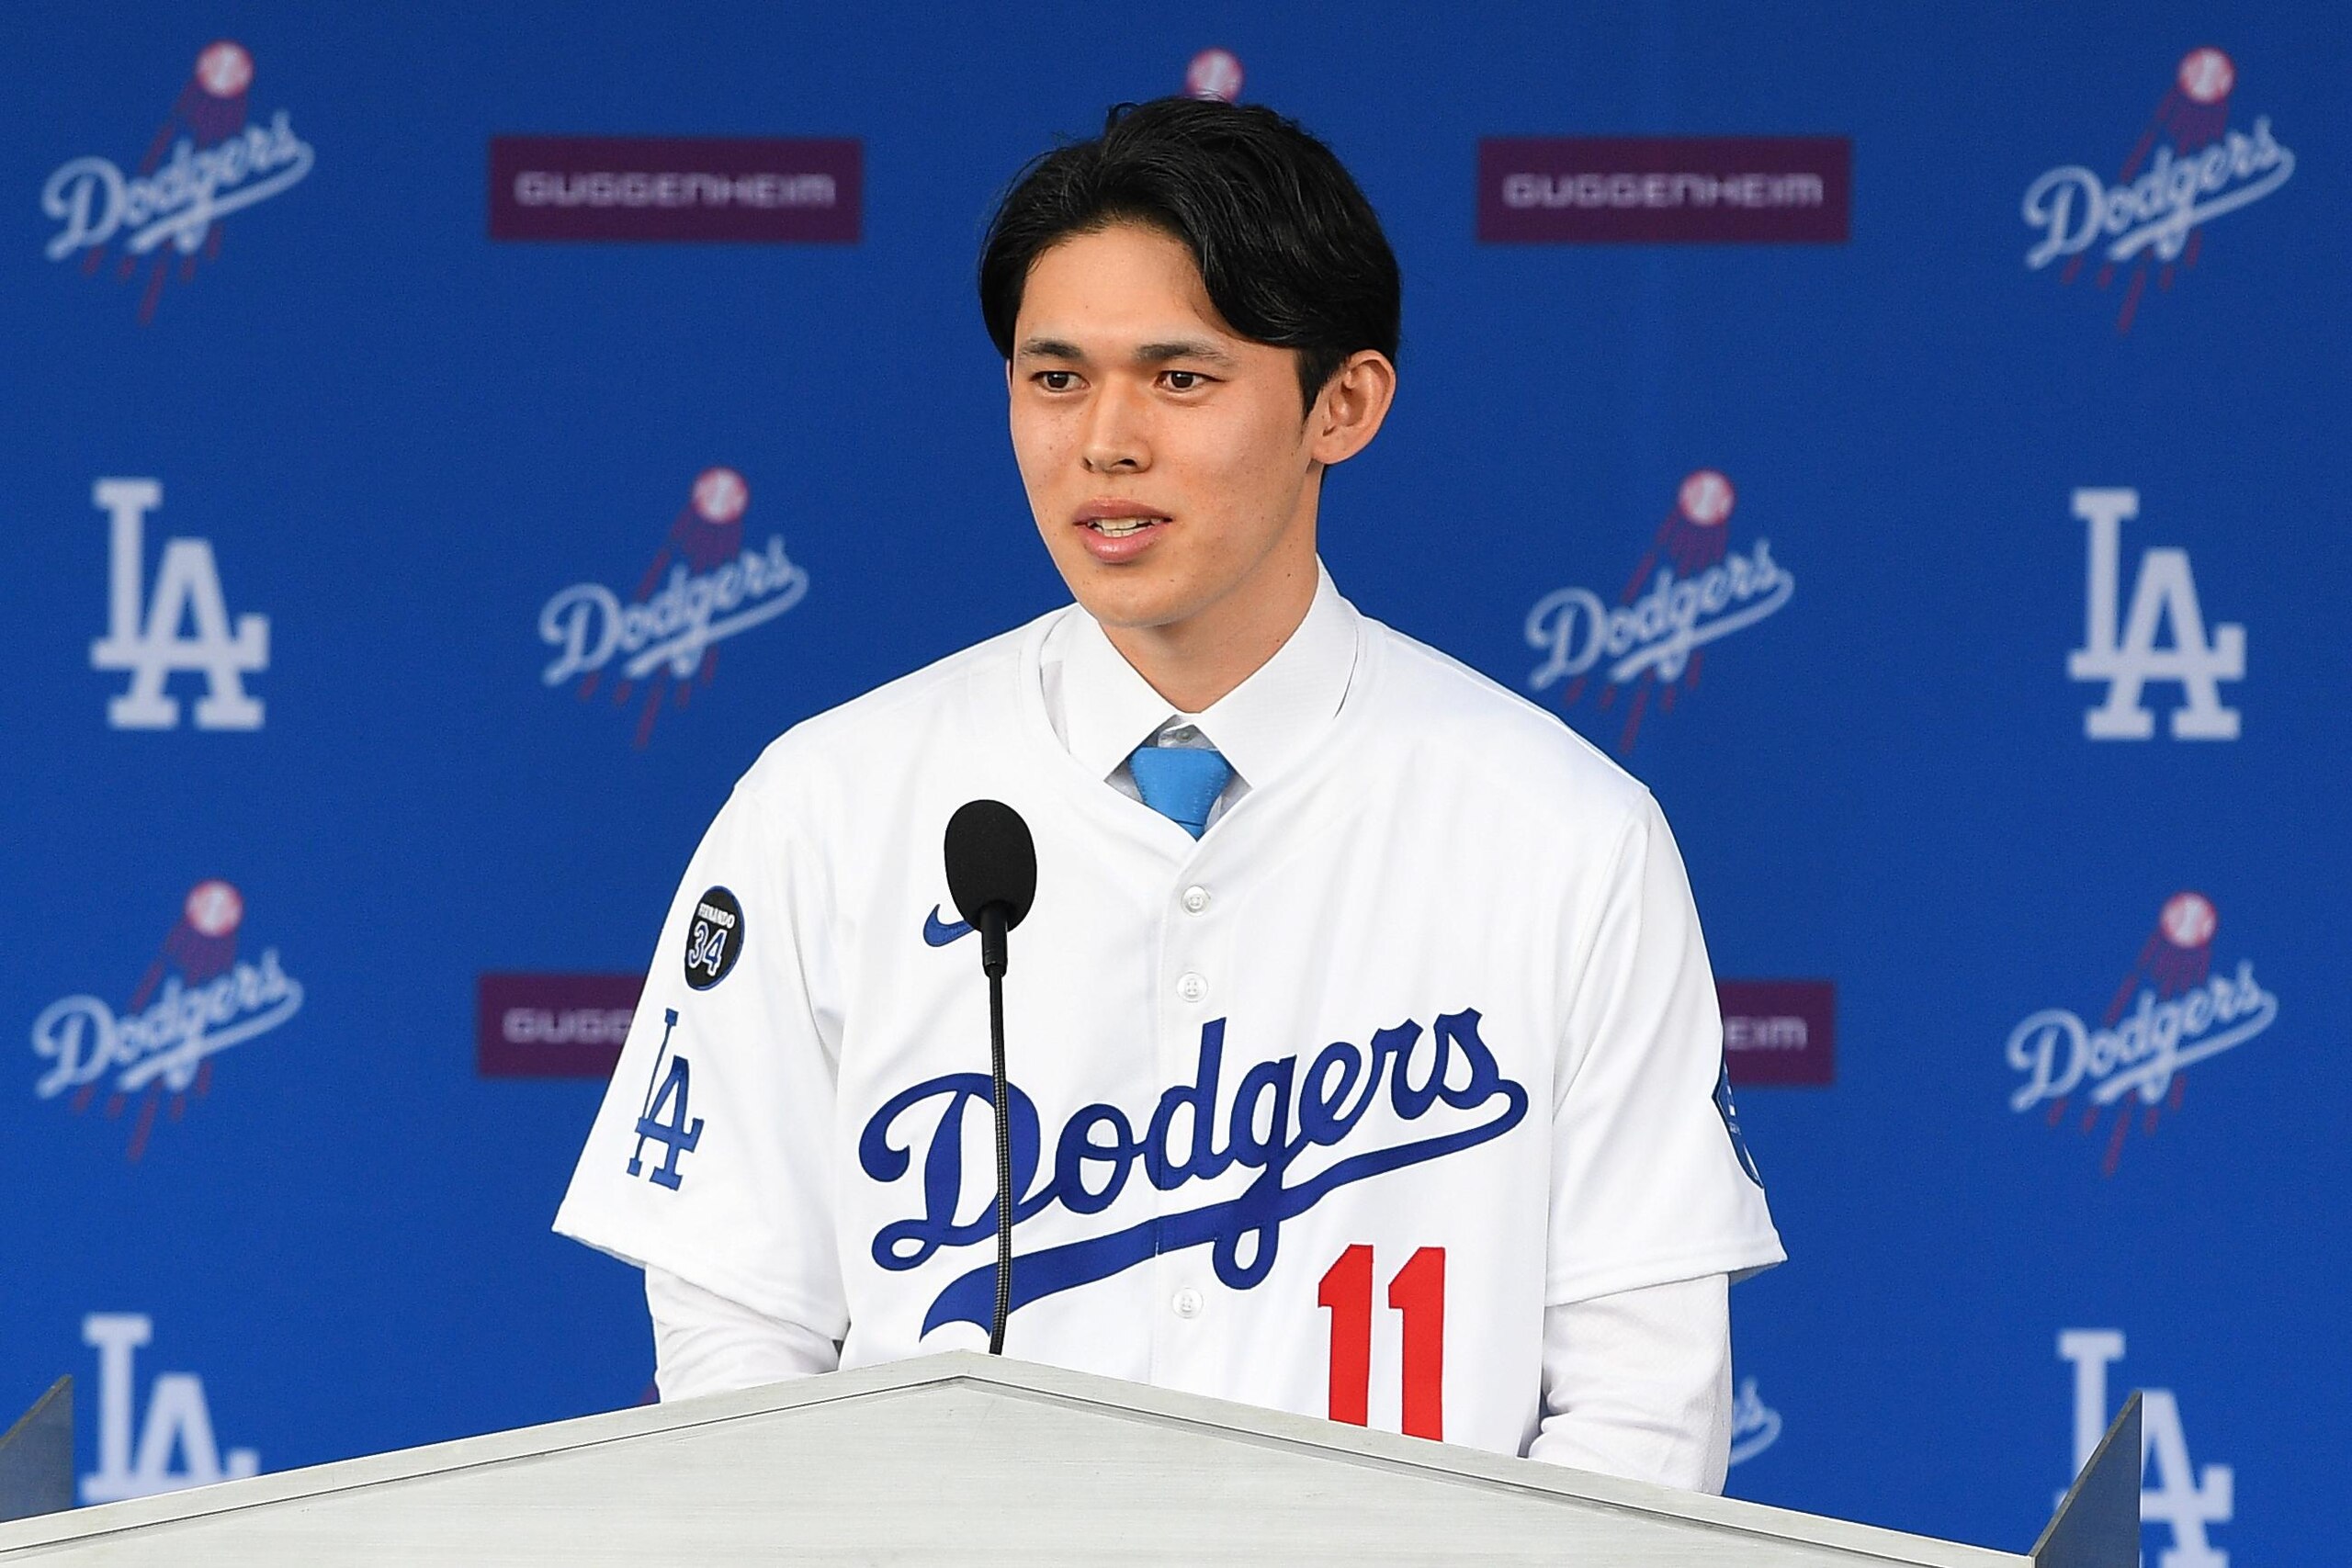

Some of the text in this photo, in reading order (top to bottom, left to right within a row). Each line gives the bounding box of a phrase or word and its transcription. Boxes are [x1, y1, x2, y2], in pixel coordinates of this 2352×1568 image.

[42, 111, 314, 261] Dodgers
[514, 171, 837, 208] GUGGENHEIM
[1502, 172, 1824, 209] GUGGENHEIM
[2023, 117, 2295, 269] Dodgers
[91, 479, 269, 730] LA
[539, 535, 808, 686] Dodgers
[1525, 540, 1793, 691] Dodgers
[2067, 488, 2246, 740] LA
[688, 920, 727, 976] 34
[32, 949, 303, 1100] Dodgers
[627, 1008, 705, 1191] LA
[2007, 961, 2278, 1112] Dodgers
[859, 1008, 1529, 1343] Dodgers
[1317, 1244, 1446, 1442] 11
